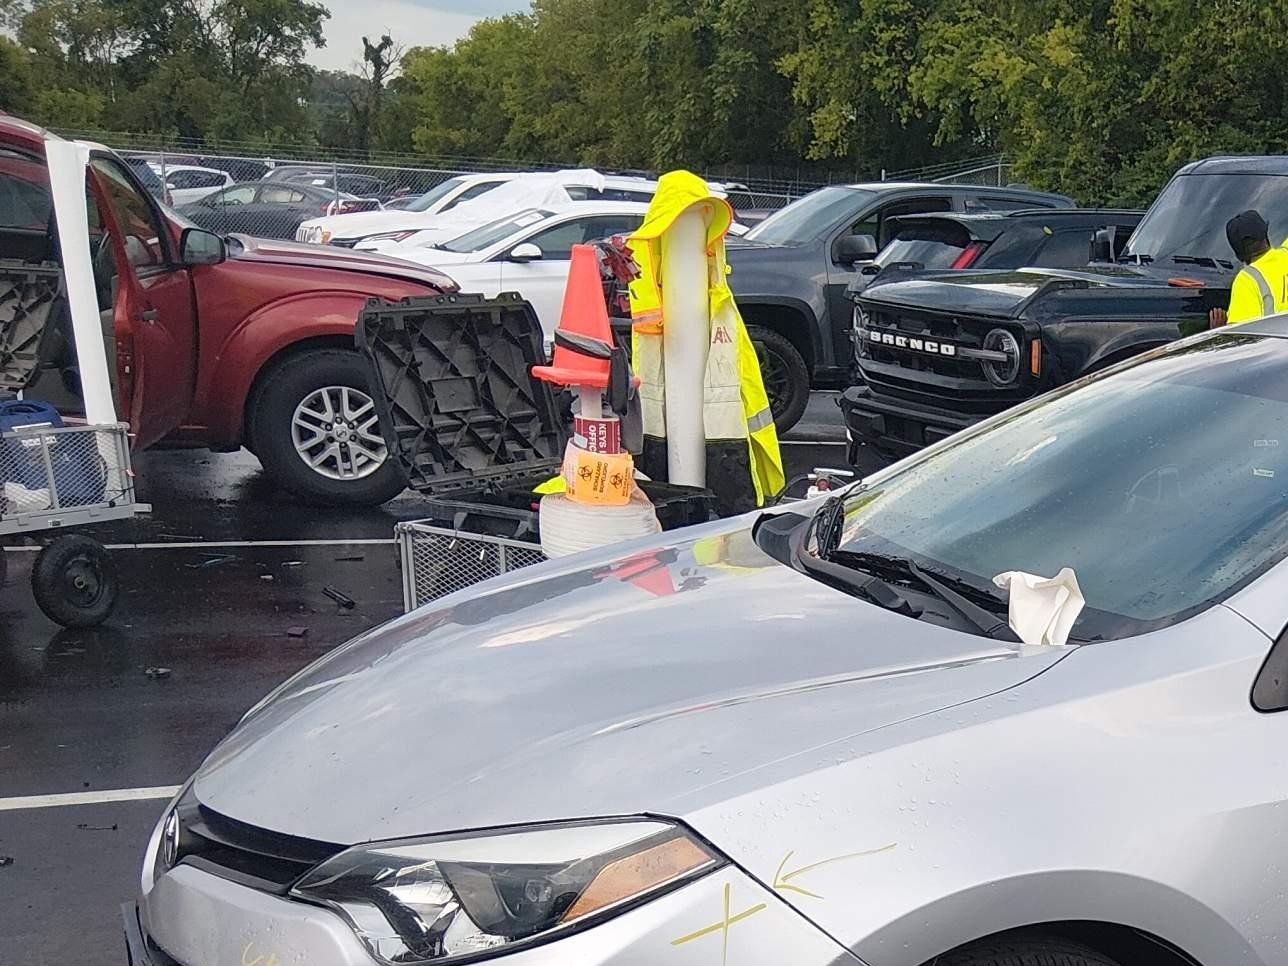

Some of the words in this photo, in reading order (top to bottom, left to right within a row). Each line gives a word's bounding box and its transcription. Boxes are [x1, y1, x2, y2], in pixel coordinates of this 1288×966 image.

[870, 331, 955, 355] BRONCO
[588, 425, 597, 453] OFFIC
[599, 423, 607, 448] KEYS
